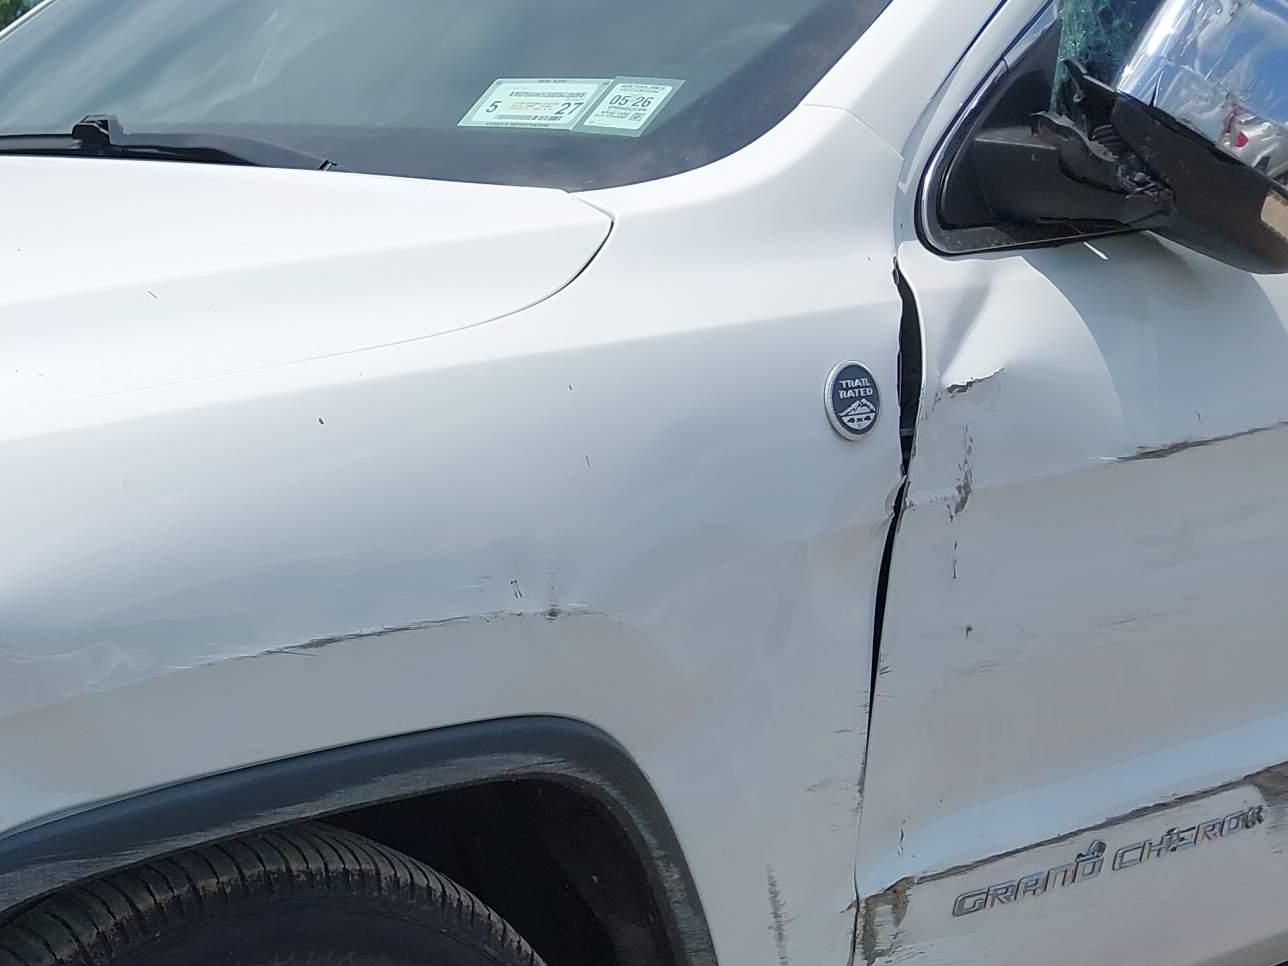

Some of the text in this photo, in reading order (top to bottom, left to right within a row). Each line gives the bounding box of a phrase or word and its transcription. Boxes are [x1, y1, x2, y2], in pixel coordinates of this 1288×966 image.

[486, 101, 502, 113] 5
[555, 102, 584, 115] 27
[609, 94, 654, 108] 05 26
[839, 378, 871, 388] TRAIL
[838, 387, 873, 399] RATED
[952, 852, 1104, 917] GRAND
